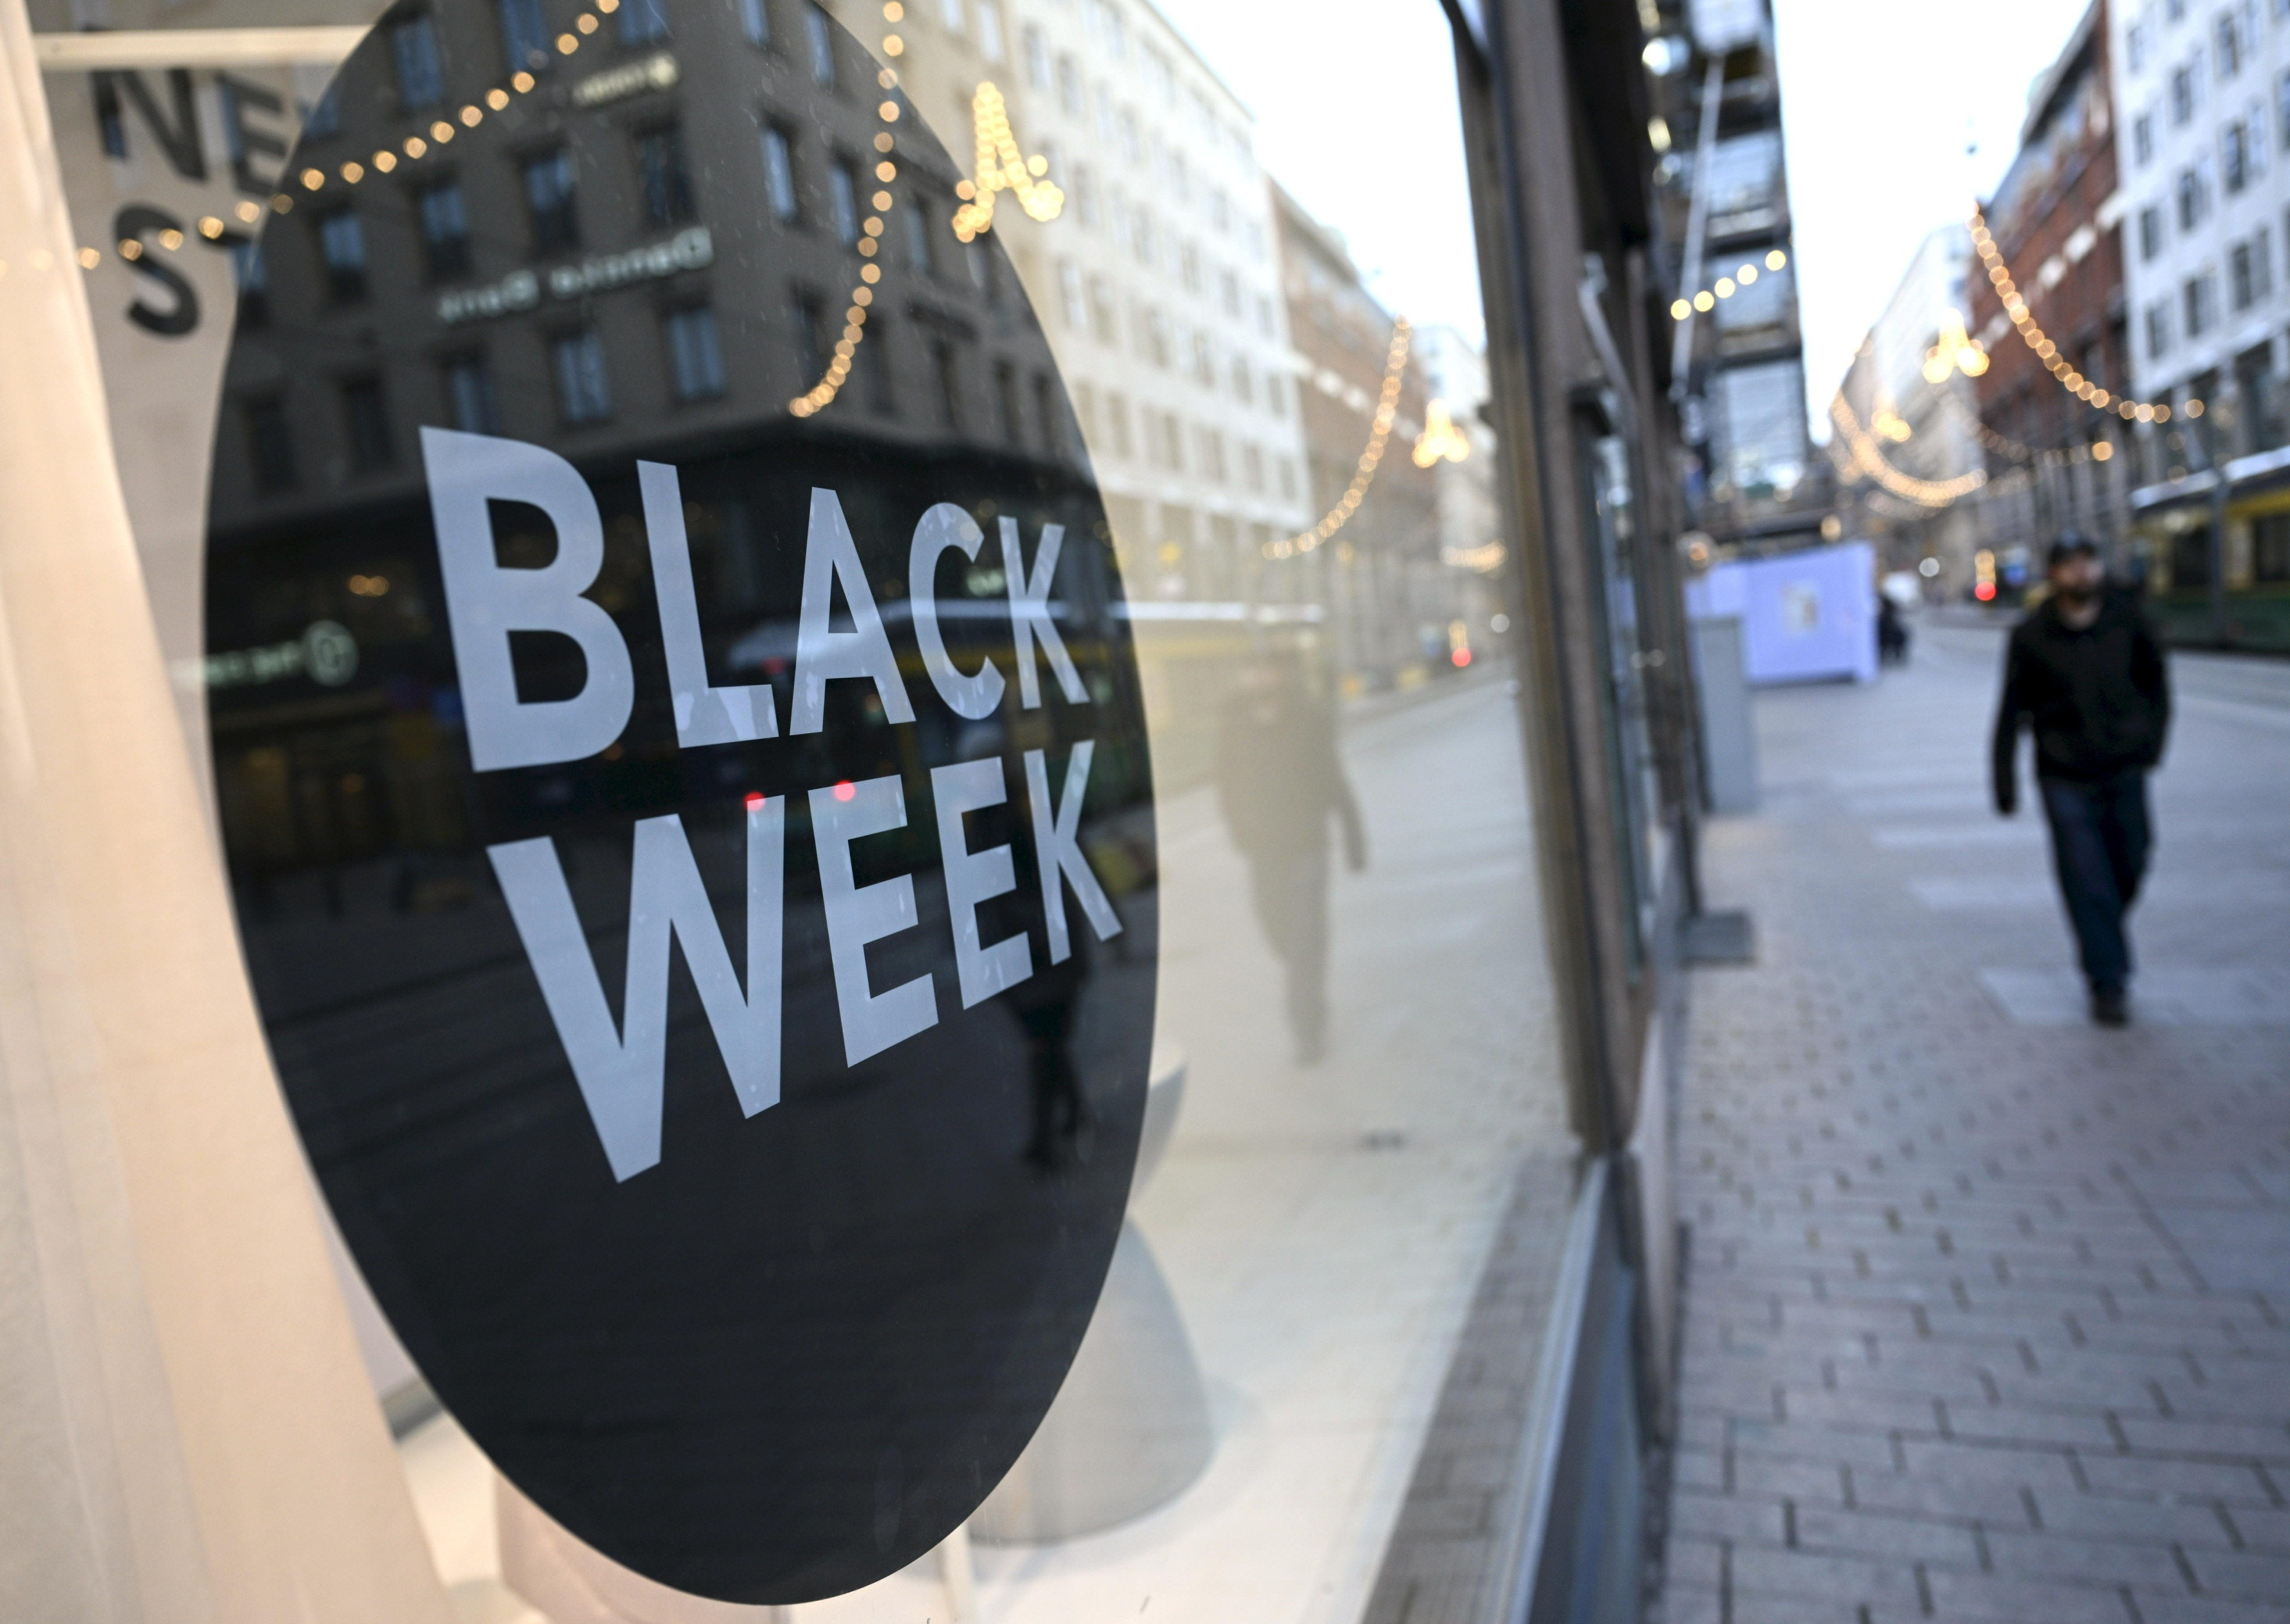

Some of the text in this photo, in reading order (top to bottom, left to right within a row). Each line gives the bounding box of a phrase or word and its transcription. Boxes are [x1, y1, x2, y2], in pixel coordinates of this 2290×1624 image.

[113, 202, 253, 340] S
[419, 426, 1089, 772] BLACK
[487, 740, 1123, 1183] WEEK
